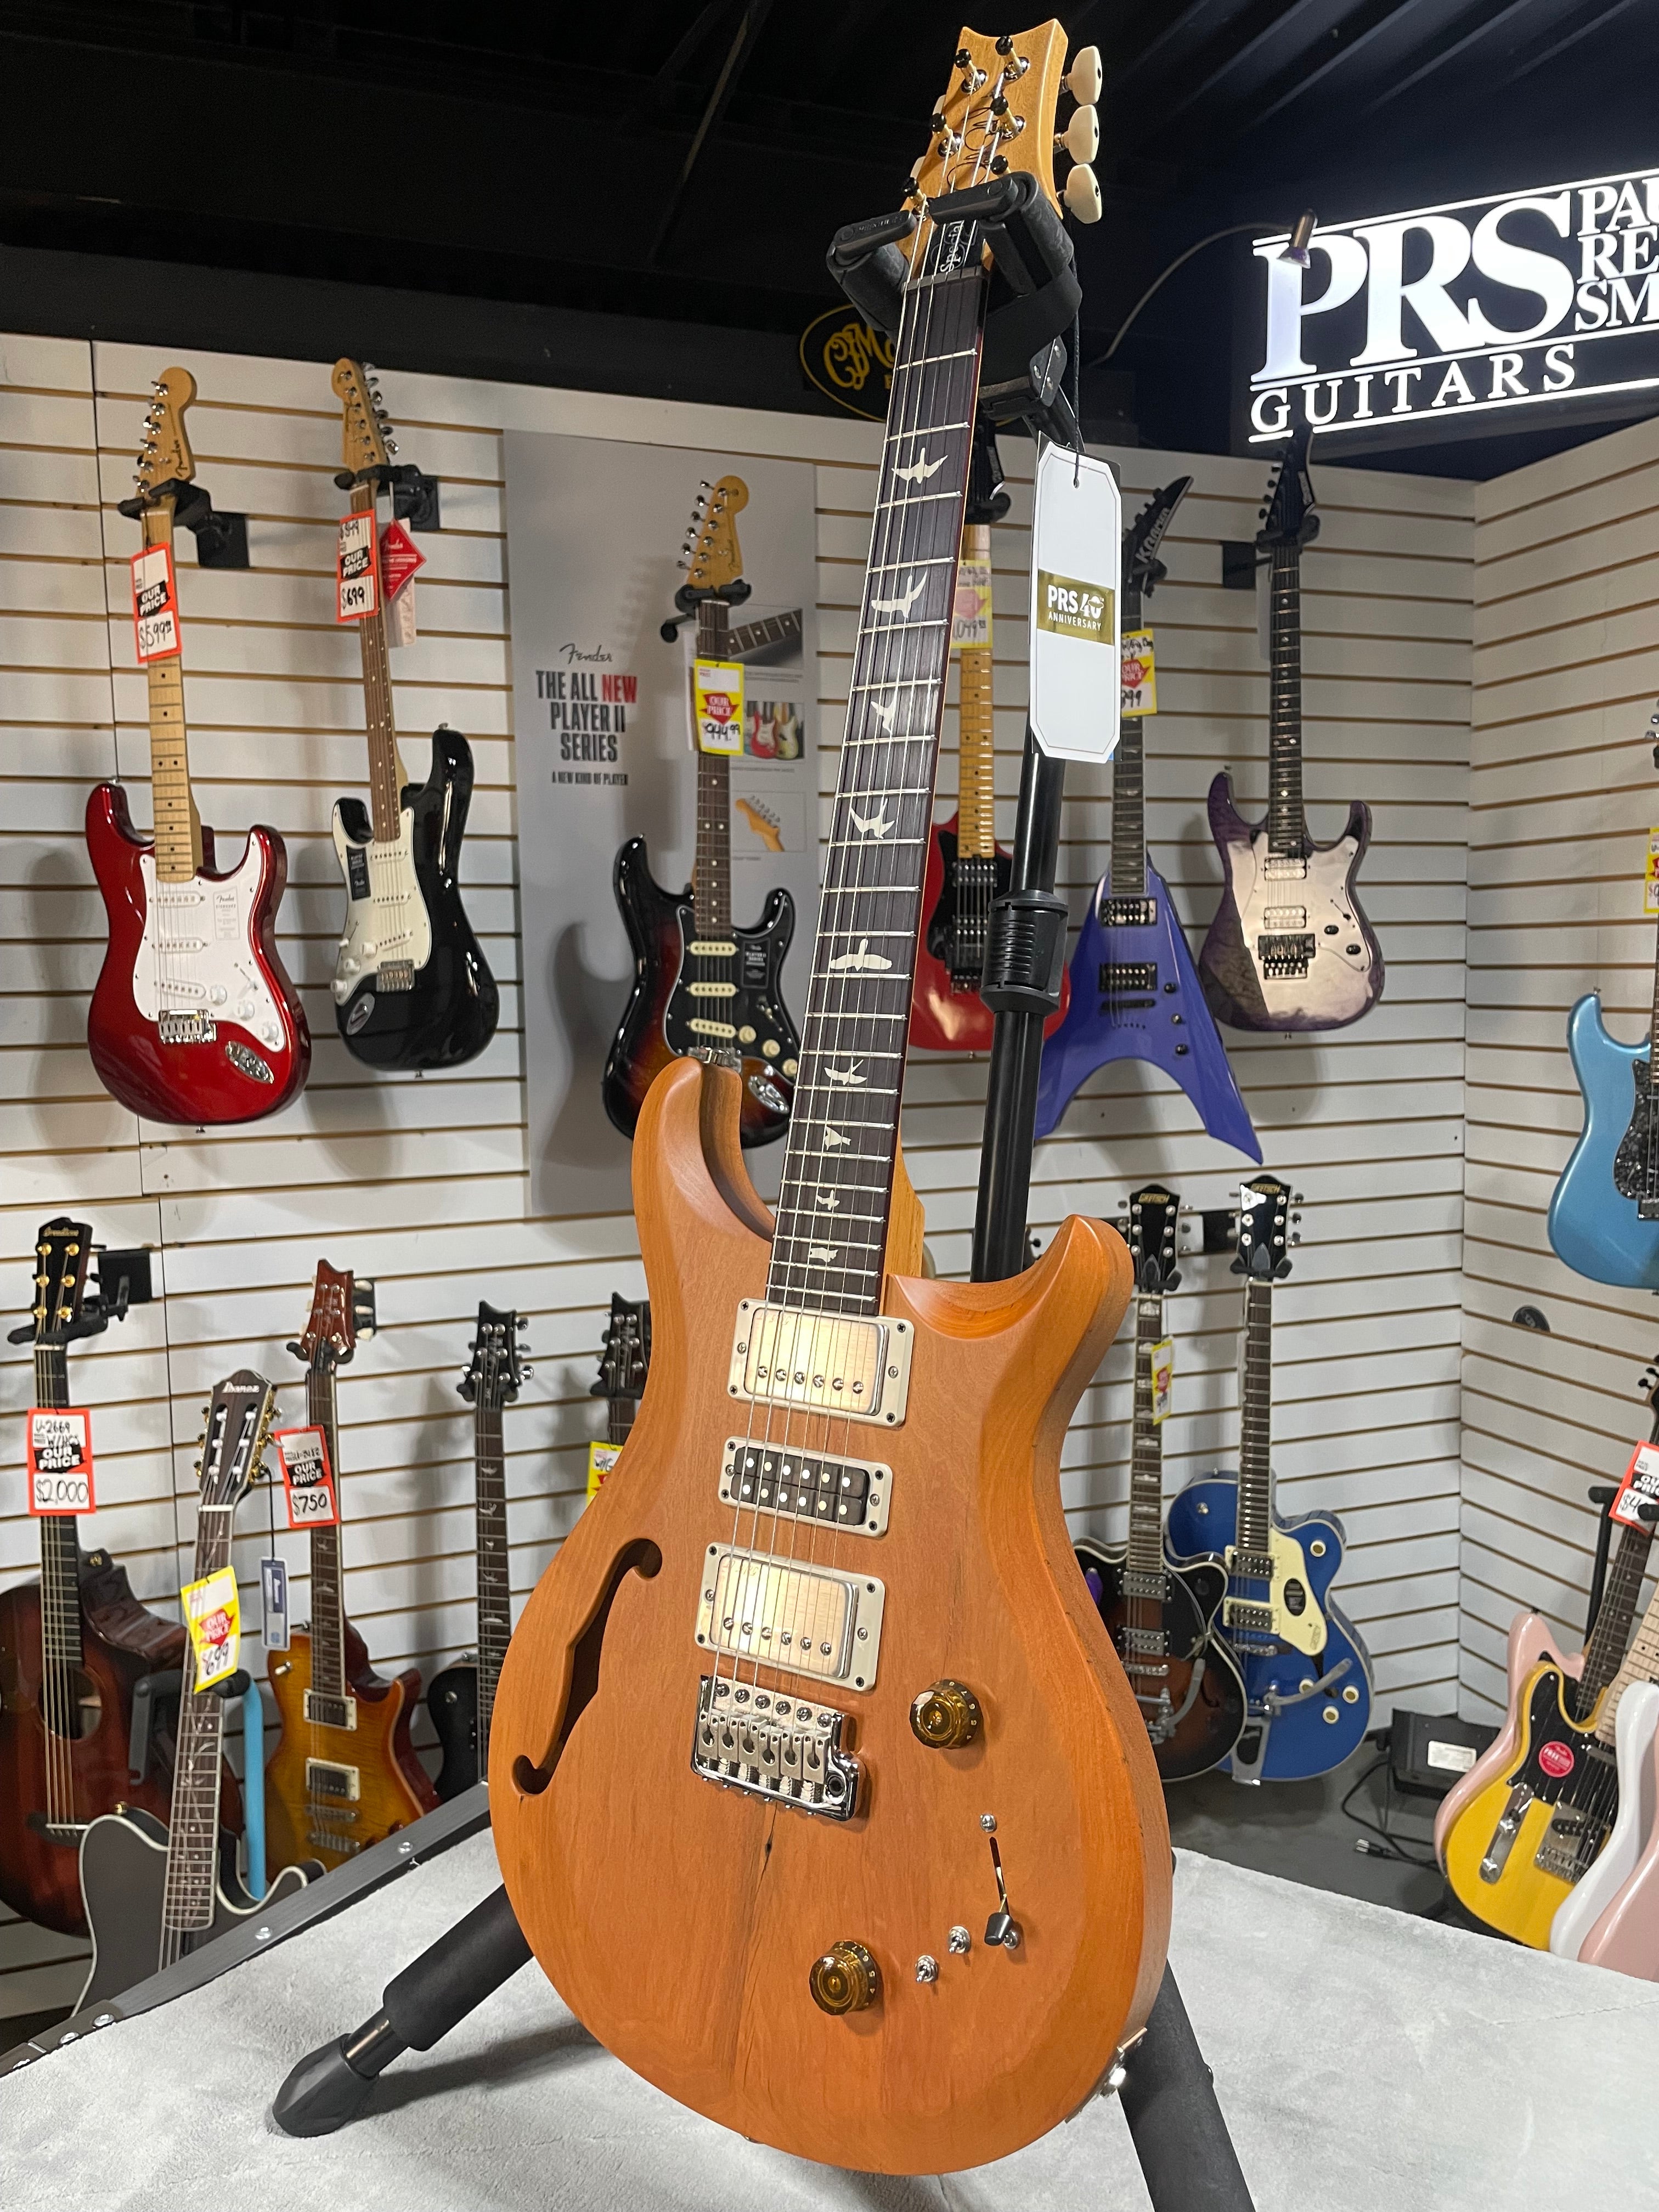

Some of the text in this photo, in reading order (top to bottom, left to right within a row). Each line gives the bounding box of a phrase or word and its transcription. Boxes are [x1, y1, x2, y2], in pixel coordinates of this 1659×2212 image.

[940, 221, 964, 272] Special
[1251, 191, 1574, 383] PRS
[1250, 343, 1575, 435] GUITARS
[343, 557, 368, 577] PRICE
[345, 549, 363, 566] OUR
[140, 592, 167, 616] PRICE
[142, 585, 161, 603] OUR
[342, 586, 364, 610] $699
[1048, 584, 1079, 614] PRS
[1048, 611, 1102, 631] ANNIVERSARY
[560, 643, 612, 664] Fender
[536, 670, 637, 703] THE ALL NEW
[707, 706, 732, 716] PRICE
[709, 696, 729, 706] OUR
[551, 702, 625, 732] PLAYER II
[561, 732, 618, 762] SERIES
[603, 773, 628, 786] PLAYER
[222, 1381, 259, 1393] Ibanez
[39, 1455, 80, 1470] PRICE
[43, 1447, 72, 1459] OUR
[293, 1469, 323, 1486] PRICE
[295, 1462, 315, 1474] OUR
[292, 1493, 327, 1516] $750
[206, 1612, 227, 1629] OUR
[206, 1623, 228, 1641] PRICE
